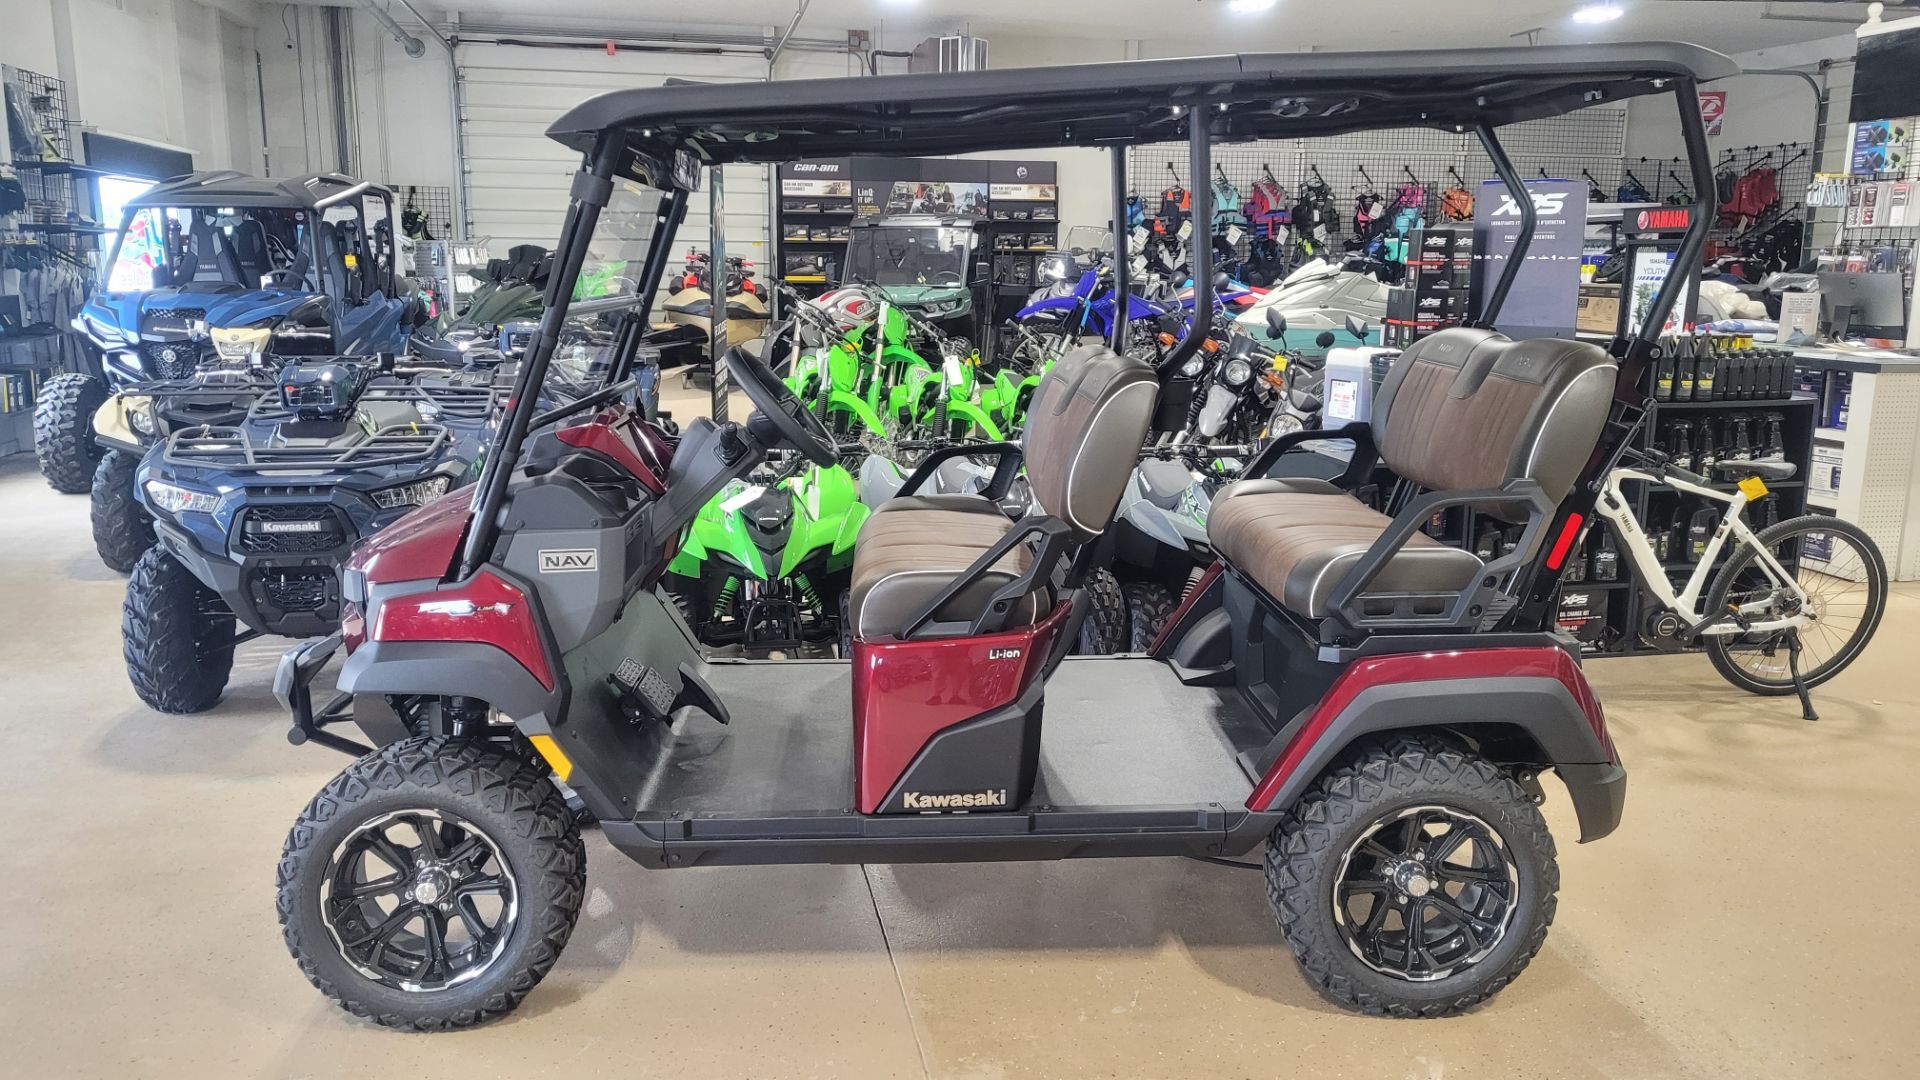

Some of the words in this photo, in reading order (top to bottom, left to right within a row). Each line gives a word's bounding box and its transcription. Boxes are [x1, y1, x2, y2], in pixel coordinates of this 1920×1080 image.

[793, 163, 840, 173] can-am
[1649, 209, 1689, 229] YAMAHA
[1424, 236, 1448, 246] XPS
[1643, 267, 1666, 275] YOUTH
[1419, 297, 1442, 307] XPS
[263, 522, 319, 532] Kawasaki
[545, 555, 592, 567] NAV
[1561, 594, 1589, 606] XPS
[989, 649, 1020, 660] Li-ion
[903, 789, 1006, 809] Kawasaki
